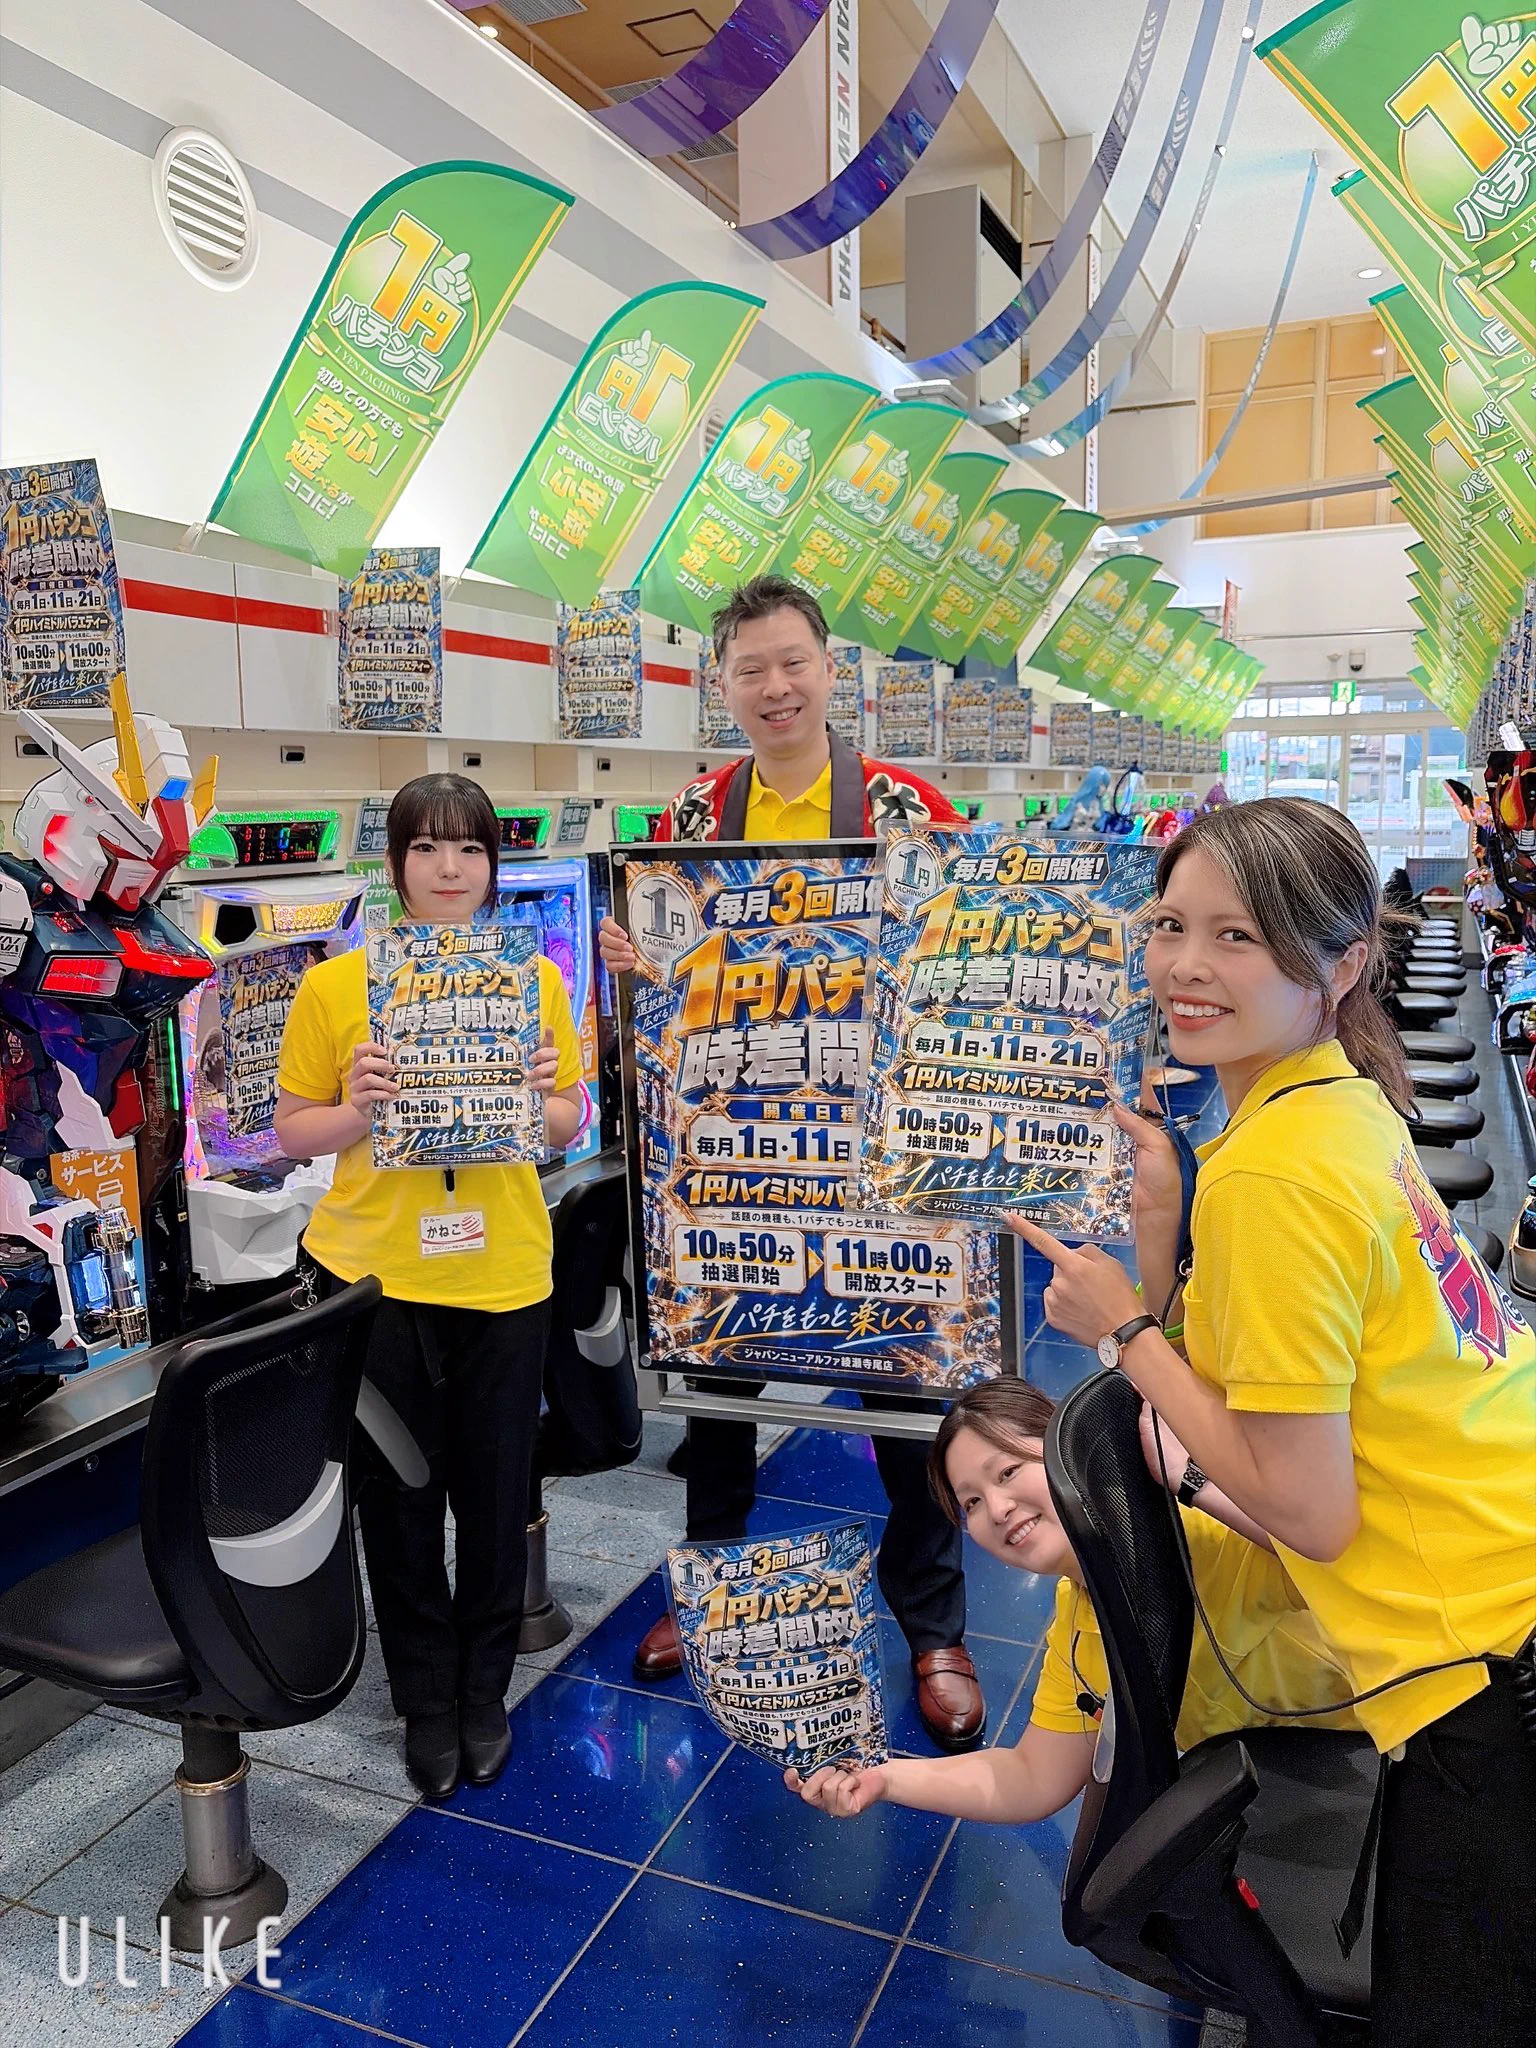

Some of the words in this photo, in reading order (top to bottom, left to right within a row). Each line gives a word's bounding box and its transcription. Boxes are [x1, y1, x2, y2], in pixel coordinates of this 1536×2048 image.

[371, 210, 466, 356] 1円
[329, 294, 444, 393] パチンコ
[342, 352, 360, 372] YEN
[360, 365, 410, 405] PACHINKO
[316, 366, 404, 439] 初めての方でも
[744, 404, 807, 495] 1円
[10, 469, 75, 499] 毎月3回開催!
[850, 430, 901, 506] 1円
[284, 472, 338, 521] ココに!
[715, 459, 789, 518] パチンコ
[822, 475, 890, 527] パチンコ
[3, 502, 97, 550] 1円パチンコ
[15, 643, 56, 660] 10時50分
[69, 643, 111, 658] 11時00分
[953, 846, 1104, 885] 毎月3回開催!
[915, 884, 1126, 964] 1円パチンコ
[410, 930, 502, 957] 毎月3回開催!
[390, 958, 521, 1007] 1円パチンコ
[909, 958, 1122, 1020] 時差開放
[392, 999, 523, 1037] 時差開放
[971, 1015, 1045, 1033] 開催日程
[400, 1047, 514, 1065] 毎月1日・11日・21日
[915, 1030, 1098, 1067] 毎月1日・11日・21日
[903, 1065, 1108, 1104] 1円ハイミドルバラエティー
[393, 1099, 449, 1115] 10時50分
[401, 1115, 441, 1125] 抽選開始
[469, 1097, 523, 1112] 11時00分
[472, 1111, 521, 1123] 開放スタート
[896, 1108, 983, 1137] 10時50分
[907, 1134, 969, 1153] 抽選開始
[1016, 1119, 1103, 1149] 11時00分
[61, 1153, 125, 1186] サービス
[1020, 1145, 1098, 1165] 開放スタート
[426, 1223, 461, 1239] かねこ
[683, 1229, 794, 1264] 10時50分
[702, 1263, 779, 1286] 抽選開始
[836, 1238, 952, 1276] 11時00分
[844, 1273, 948, 1298] 開放スタート
[720, 1541, 827, 1580] 毎月3回開催!
[700, 1577, 854, 1632] 1円パチンコ
[708, 1610, 855, 1659] 時差開放
[720, 1660, 849, 1689] 毎月1日・11日・21日
[801, 1707, 863, 1735] 11時00分
